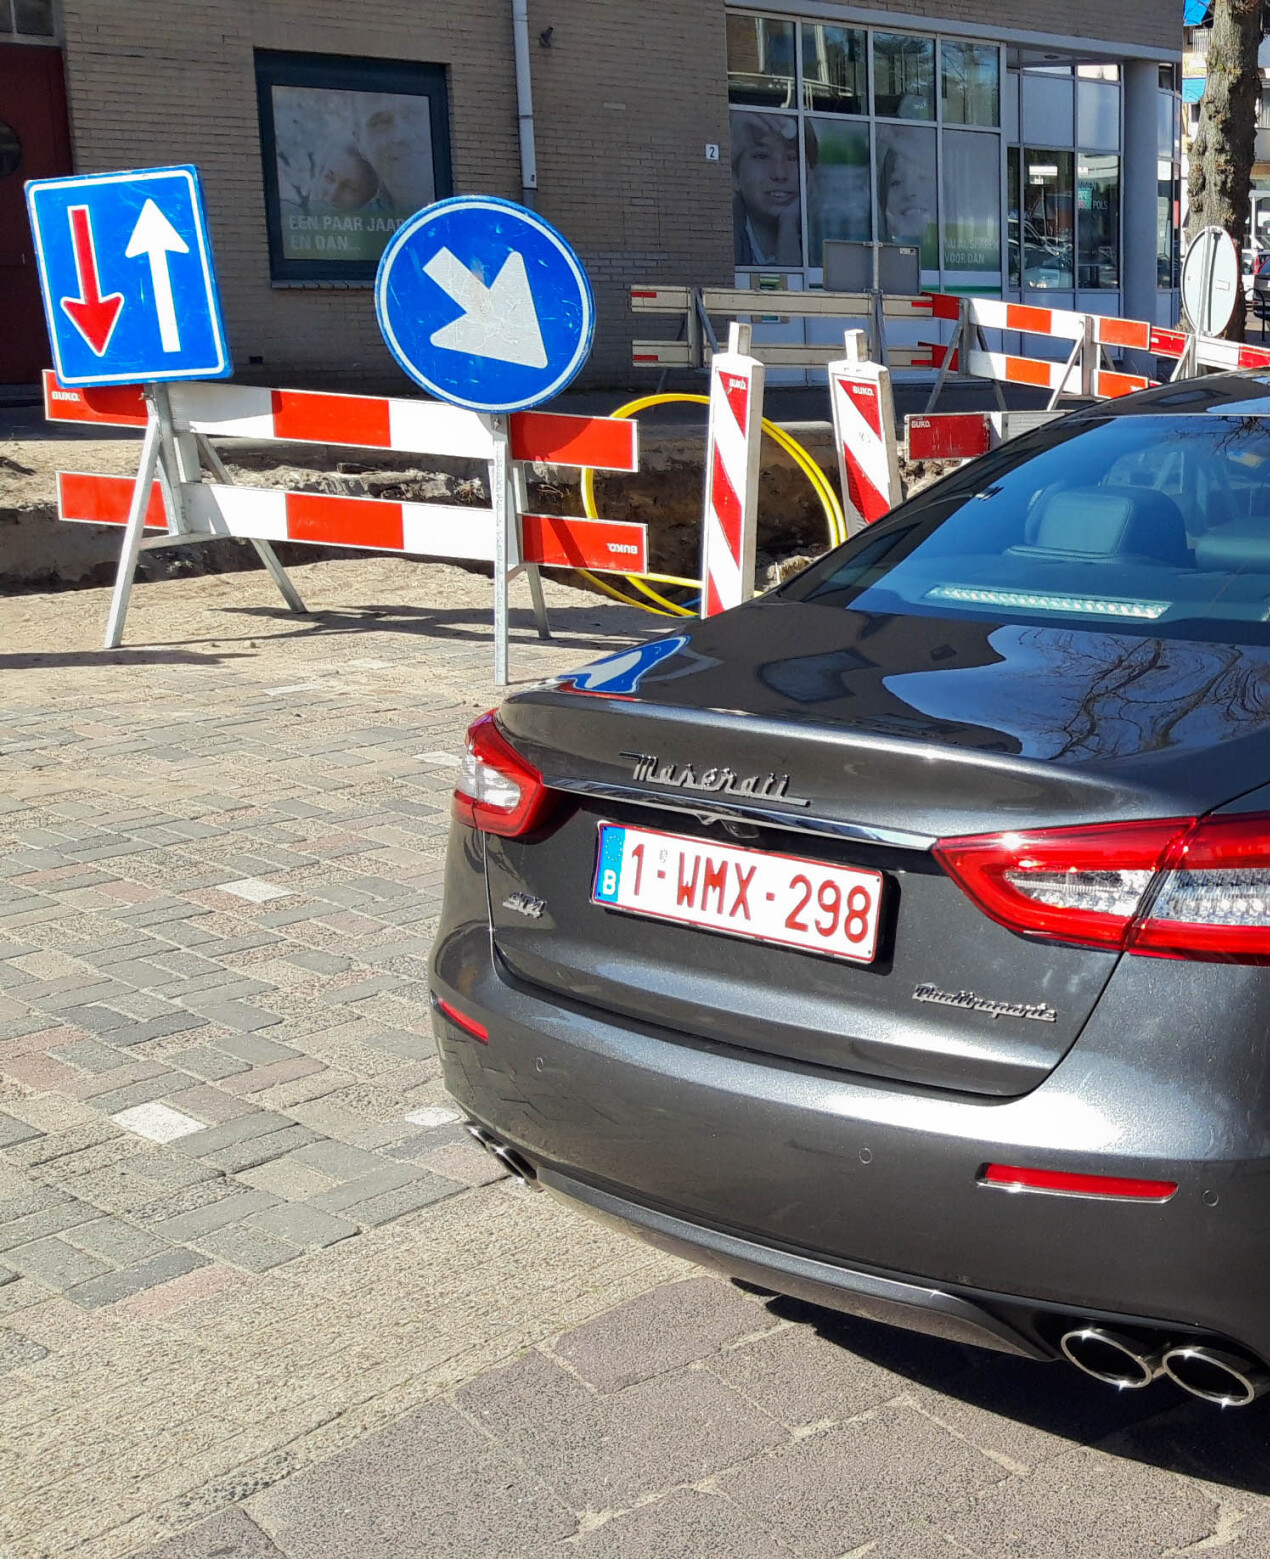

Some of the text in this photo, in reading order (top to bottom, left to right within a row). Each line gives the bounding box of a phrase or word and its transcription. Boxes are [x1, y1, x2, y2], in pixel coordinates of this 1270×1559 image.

[709, 145, 715, 158] 2
[288, 214, 319, 231] EEN
[322, 215, 363, 232] PAAR
[290, 235, 311, 250] EN
[943, 252, 985, 265] VOOR DAN
[619, 751, 812, 808] Maserati
[602, 868, 617, 896] B
